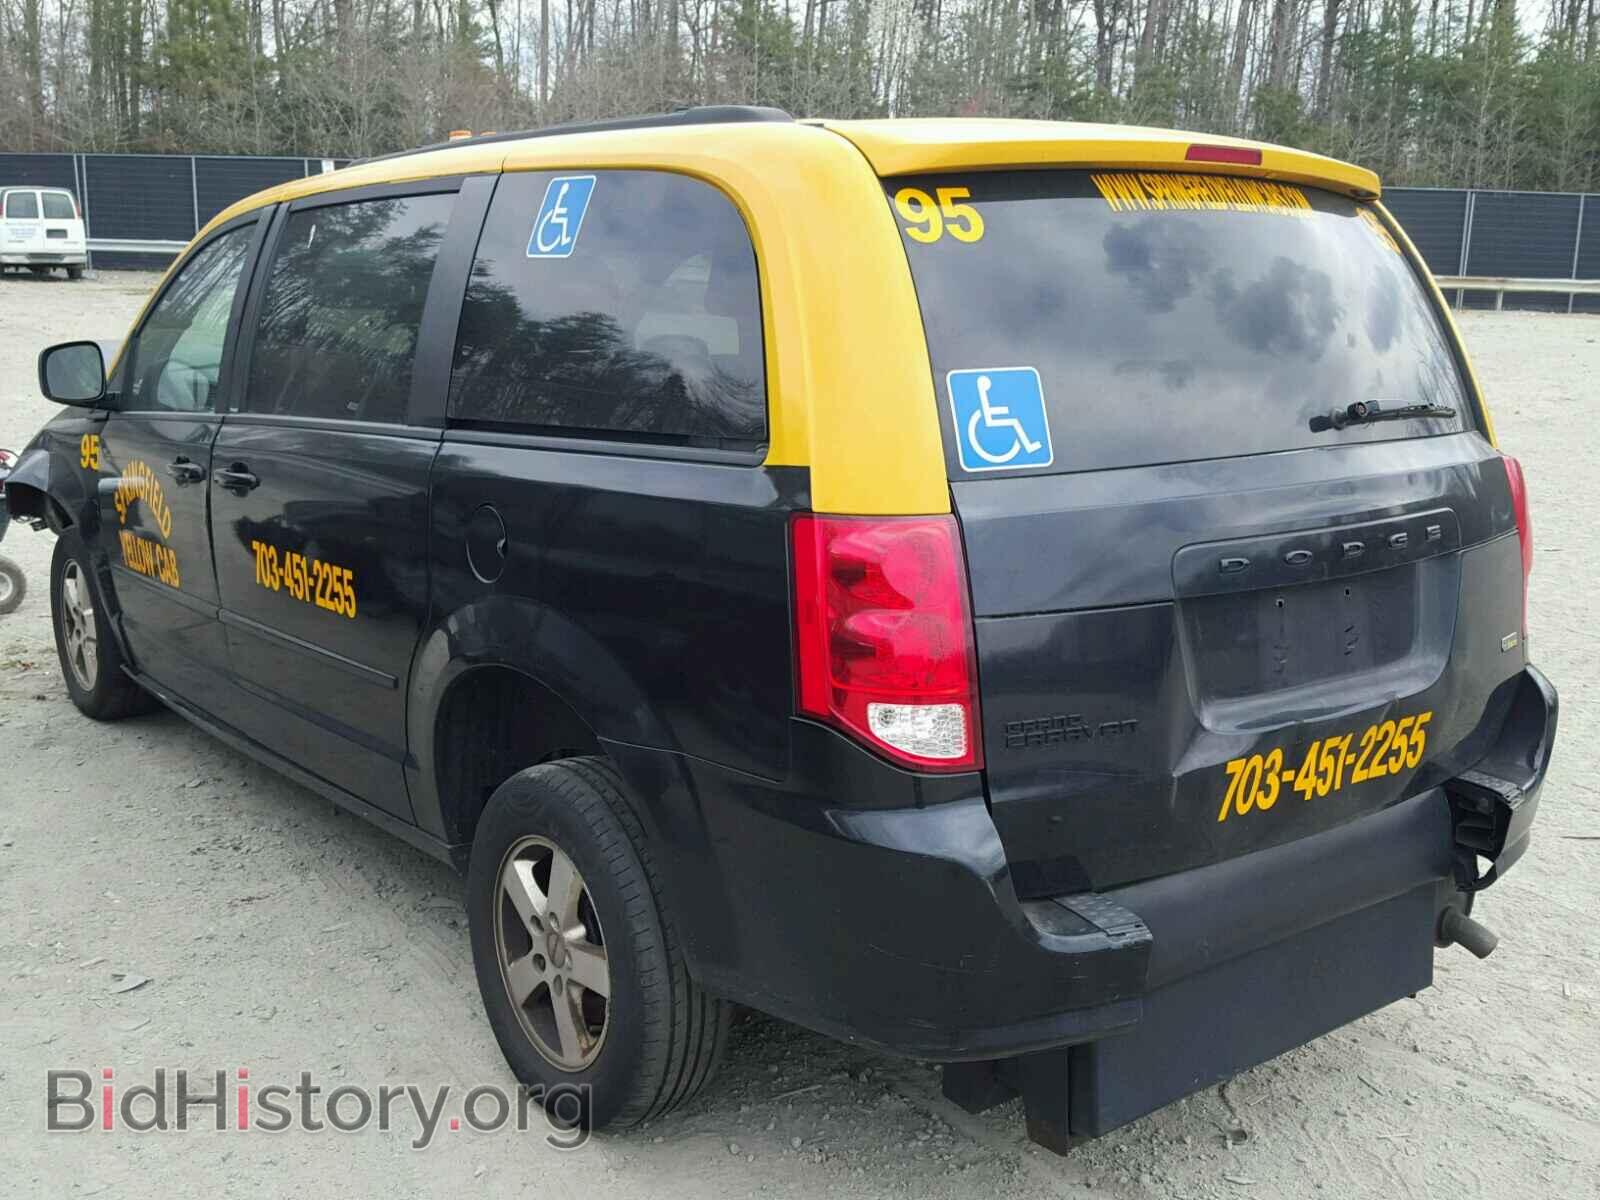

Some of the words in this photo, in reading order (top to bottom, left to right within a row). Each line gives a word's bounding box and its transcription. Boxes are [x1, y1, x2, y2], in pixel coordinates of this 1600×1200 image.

[894, 187, 985, 243] 95
[80, 433, 101, 470] 95
[113, 457, 172, 539] SPRINGFIELD
[156, 543, 180, 589] CAB
[1219, 524, 1442, 575] DODGE
[251, 540, 357, 620] 703-451-2255
[1217, 711, 1433, 823] 703-451-2255
